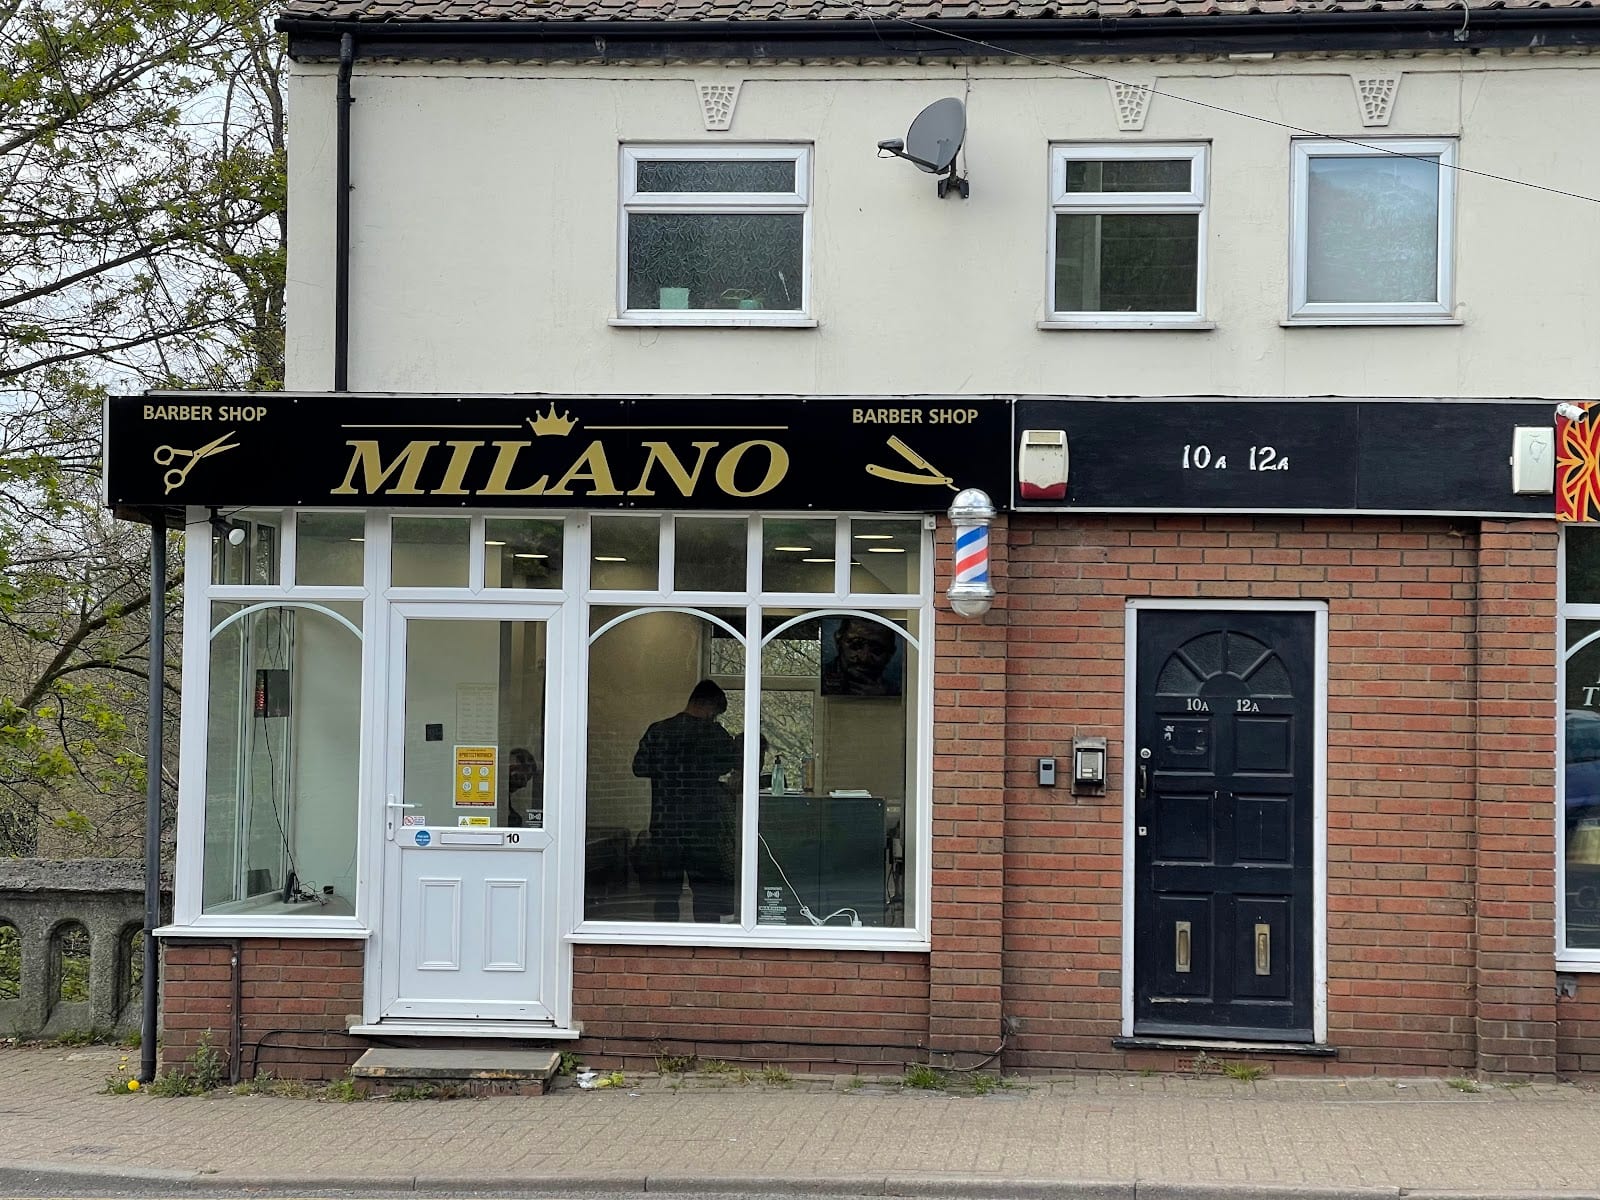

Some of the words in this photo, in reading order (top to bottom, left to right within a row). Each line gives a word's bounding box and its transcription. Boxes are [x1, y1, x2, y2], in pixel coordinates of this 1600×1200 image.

[143, 405, 213, 421] BARBER
[218, 406, 267, 422] SHOP
[852, 408, 923, 424] BARBER
[928, 409, 979, 425] SHOP
[1249, 446, 1290, 472] 12A
[330, 440, 789, 497] MILANO
[1186, 698, 1210, 712] 10A
[1236, 699, 1260, 713] 12A
[506, 833, 520, 844] 10
